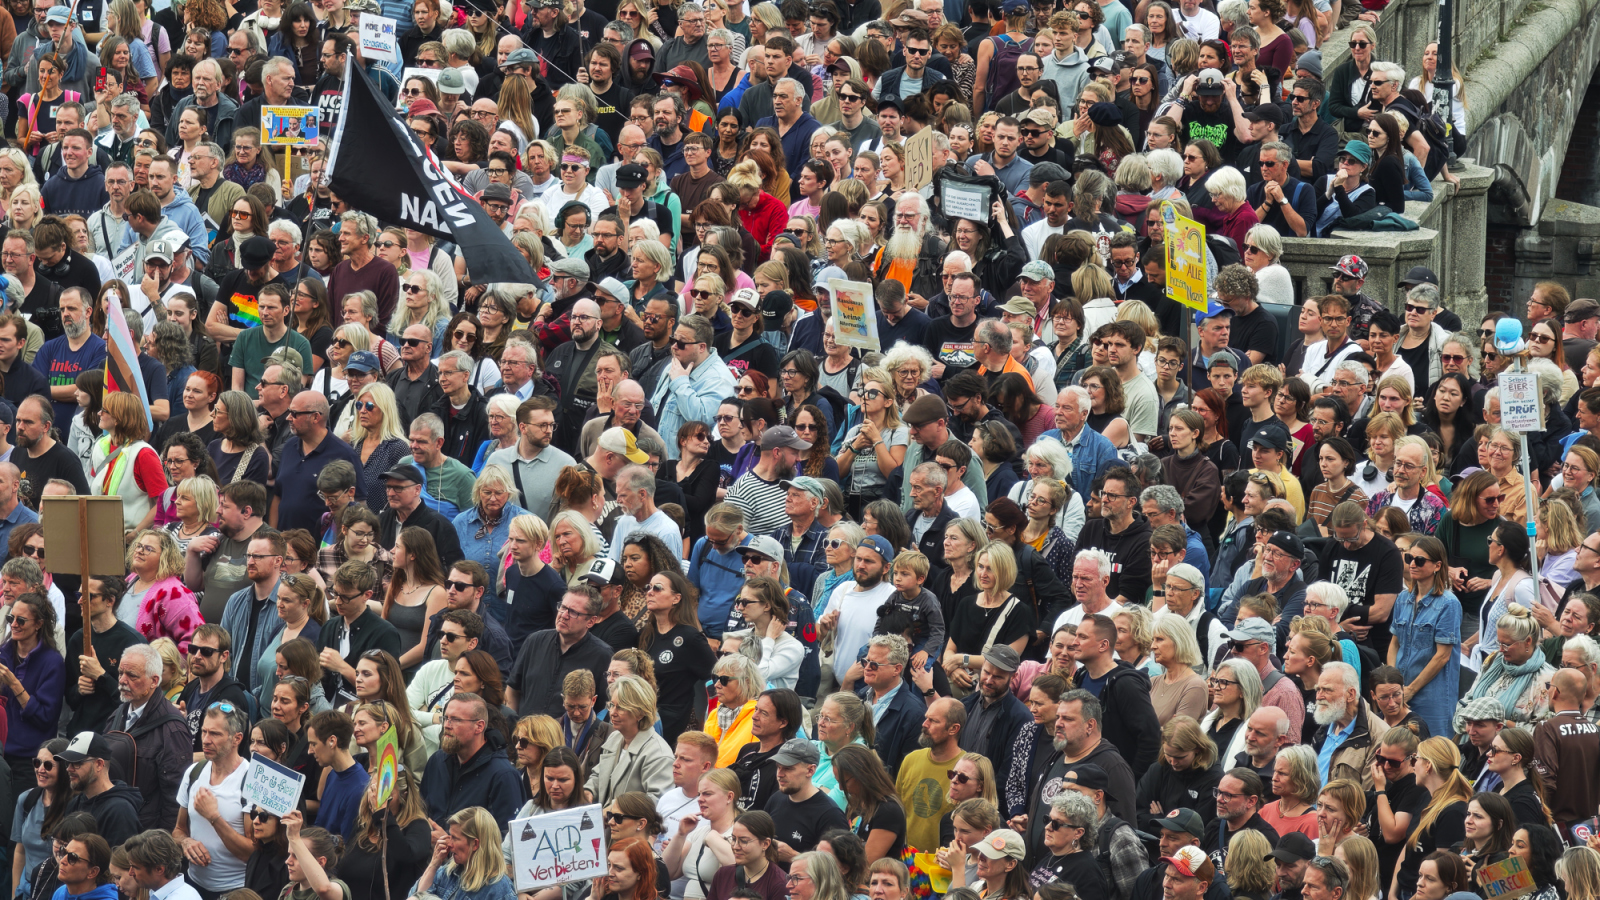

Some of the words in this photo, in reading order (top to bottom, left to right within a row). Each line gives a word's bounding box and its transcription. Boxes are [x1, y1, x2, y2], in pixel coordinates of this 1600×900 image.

[1187, 265, 1203, 281] ALLE
[50, 359, 82, 373] inks.
[1509, 382, 1528, 391] EIER
[532, 824, 581, 863] AfD
